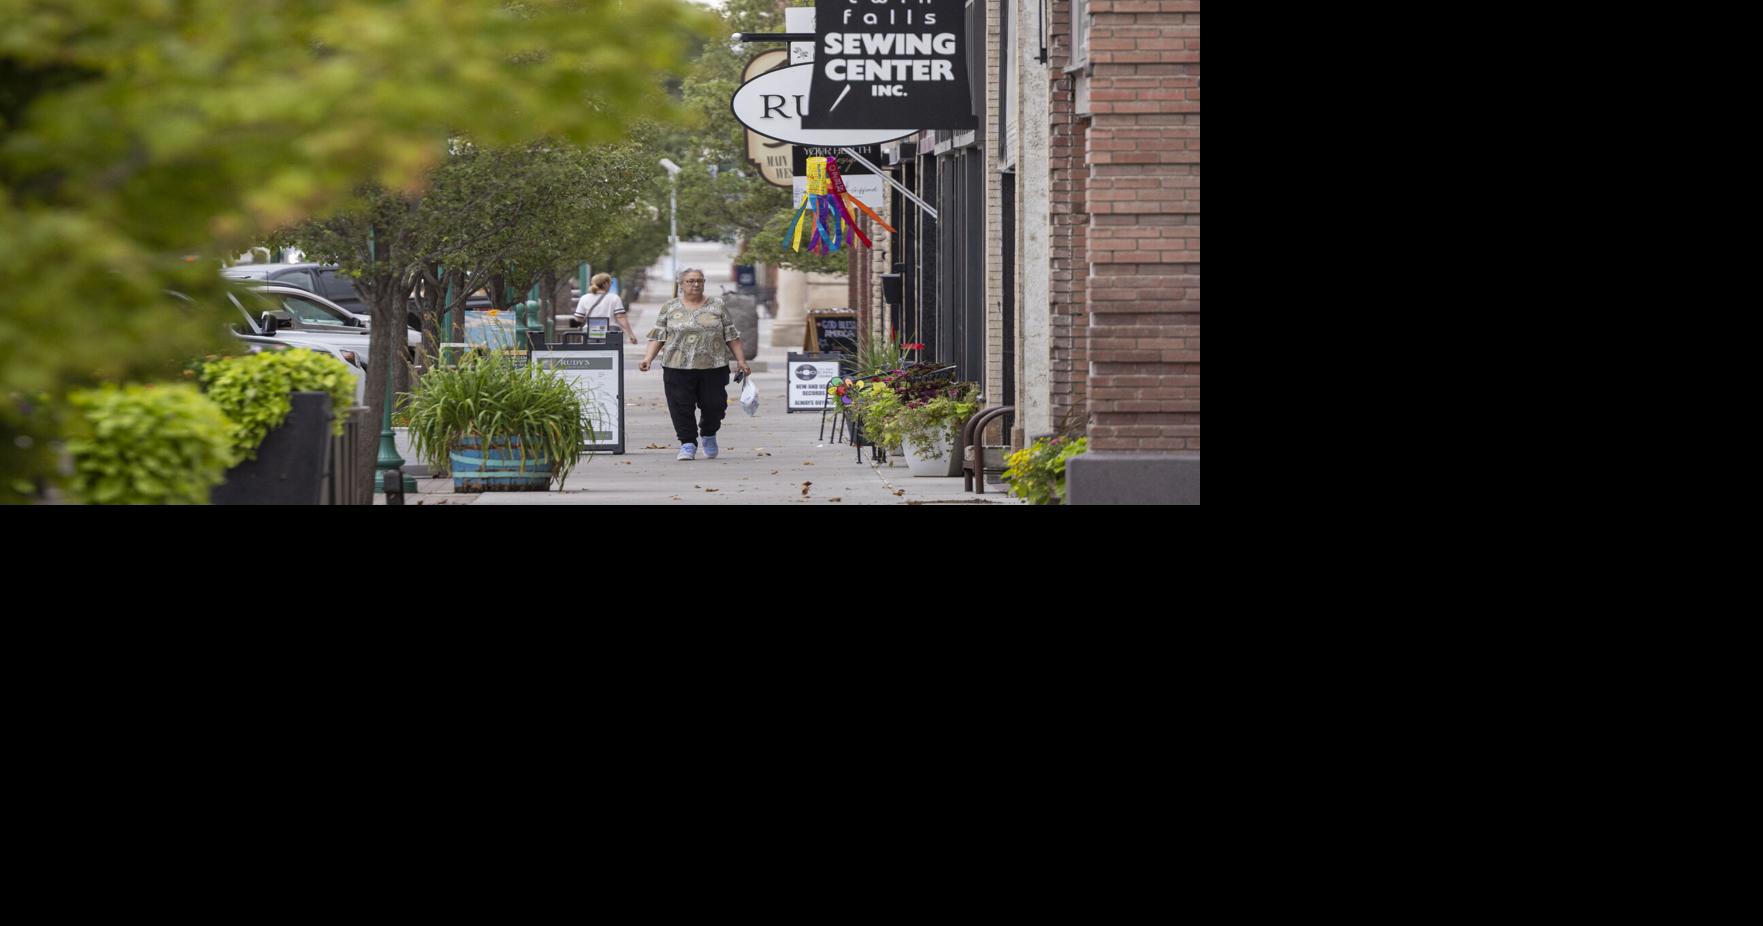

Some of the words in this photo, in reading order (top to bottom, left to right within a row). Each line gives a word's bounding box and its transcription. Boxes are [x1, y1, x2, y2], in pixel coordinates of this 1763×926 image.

[843, 9, 937, 25] falls
[824, 32, 956, 55] SEWING
[824, 58, 955, 81] CENTER
[871, 84, 908, 97] INC.
[833, 145, 872, 154] HETH
[766, 156, 788, 167] MAIN
